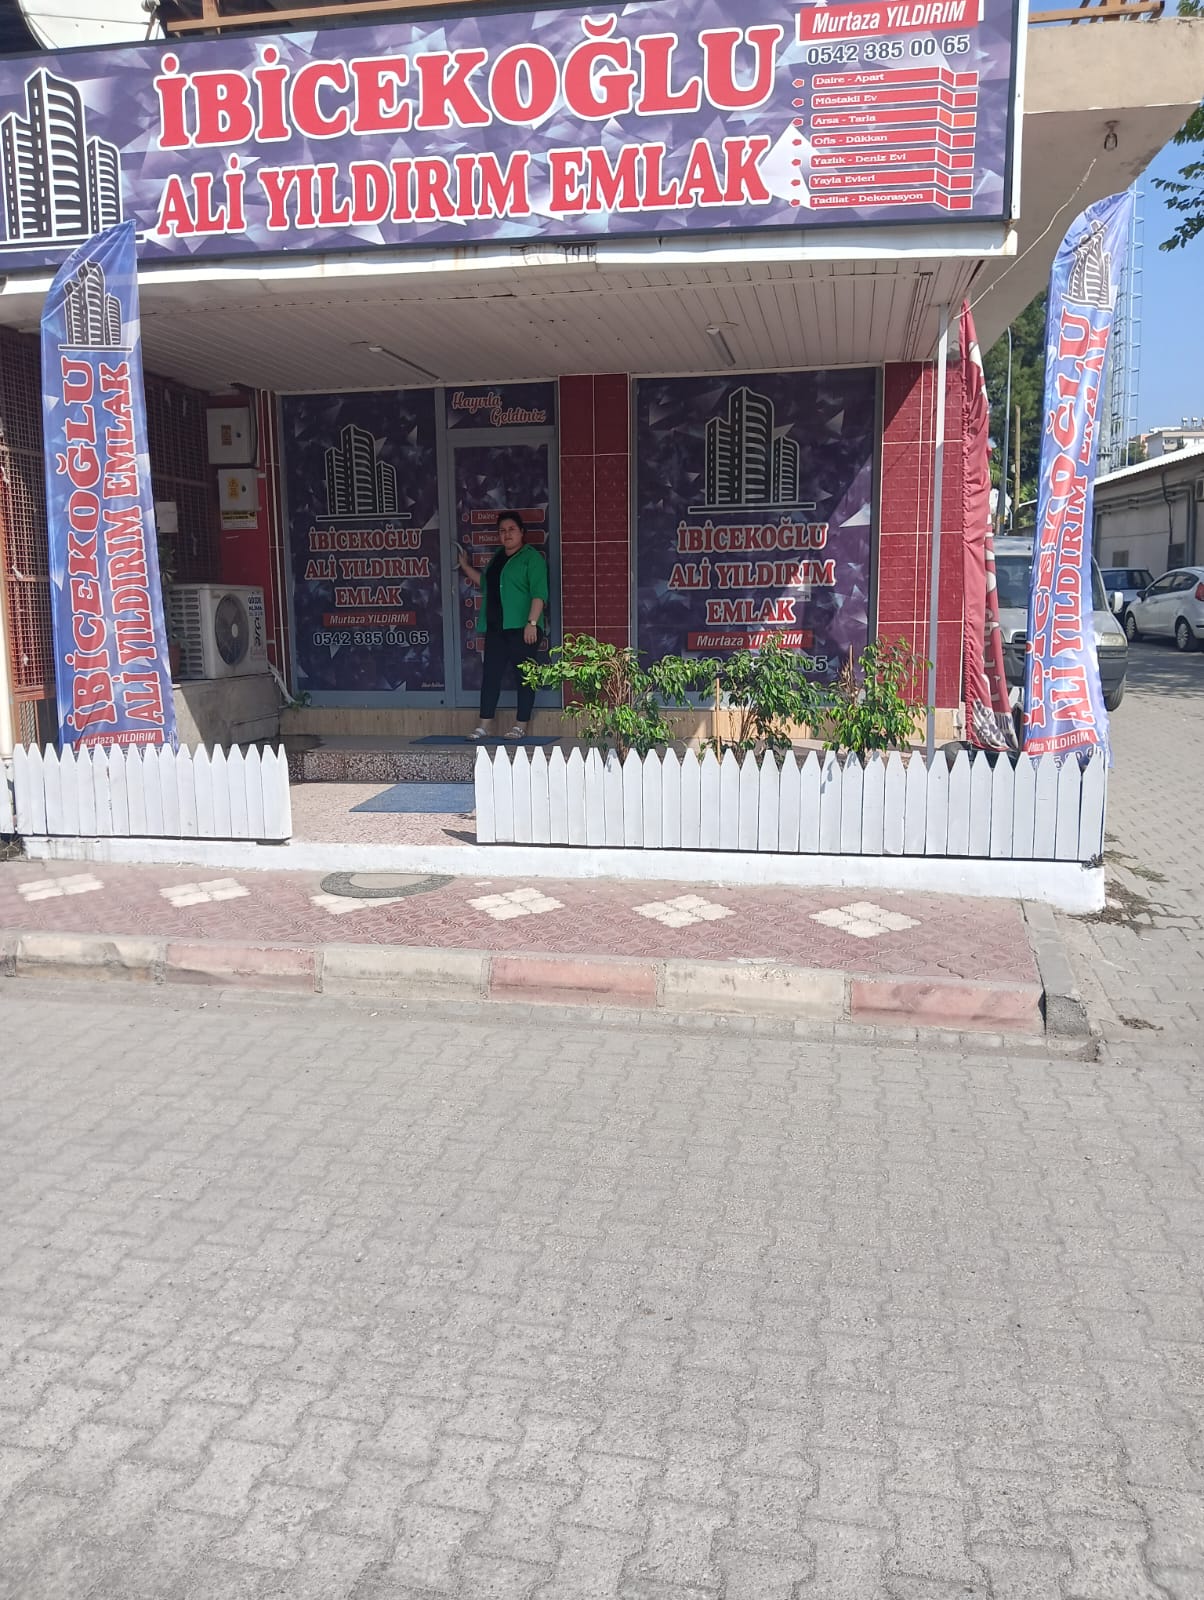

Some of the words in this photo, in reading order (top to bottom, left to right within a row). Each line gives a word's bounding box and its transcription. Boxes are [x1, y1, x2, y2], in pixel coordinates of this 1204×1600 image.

[812, 11, 880, 35] Murtaza
[885, 0, 966, 28] YILDIRIM
[806, 45, 859, 66] 0542
[863, 41, 904, 62] 385
[910, 38, 936, 58] 00
[942, 34, 970, 55] 65
[153, 13, 784, 151] İBİCEKOĞLU
[815, 76, 845, 86] Daire
[854, 73, 884, 84] Apart
[814, 95, 861, 106] Müstakil
[863, 94, 878, 102] Ev
[814, 116, 839, 125] Arsa
[848, 113, 877, 123] Tarla
[814, 136, 837, 145] Ofis
[846, 133, 888, 143] Dükkan
[813, 155, 846, 165] Yazlık
[855, 154, 887, 164] Deniz
[889, 152, 907, 162] Evi
[154, 154, 248, 236] ALİ
[259, 151, 533, 230] YILDIRIM
[547, 134, 773, 216] EMLAK
[812, 176, 842, 187] Yayla
[844, 173, 876, 184] Evleri
[812, 194, 849, 205] Tadilat
[858, 191, 924, 203] Dekorasyon
[489, 406, 547, 425] Geldiniz
[99, 360, 139, 500] EMLAK
[56, 355, 118, 735] İBİCEKOĞLU
[308, 524, 423, 551] İBİCEKOĞLU
[678, 518, 829, 552] İBİCEKOĞLU
[304, 553, 337, 581] ALİ
[339, 556, 431, 580] YILDIRIM
[669, 559, 711, 590] ALİ
[714, 558, 837, 590] YILDIRIM
[1050, 475, 1088, 659] YILDIRIM
[103, 504, 153, 661] YILDIRIM
[334, 586, 404, 608] EMLAK
[705, 596, 797, 625] EMLAK
[329, 613, 365, 625] Murtaza
[368, 612, 409, 624] YILDIRIM
[312, 632, 351, 646] 0542
[353, 631, 383, 645] 385
[387, 631, 406, 644] 00
[410, 630, 430, 644] 65
[696, 634, 744, 648] Murtaza
[747, 633, 803, 646] YILRIM
[112, 668, 165, 726] ALİ
[1044, 664, 1094, 726] ALİ
[116, 731, 157, 744] YILDIRIM
[1046, 731, 1090, 752] YILDIRIM
